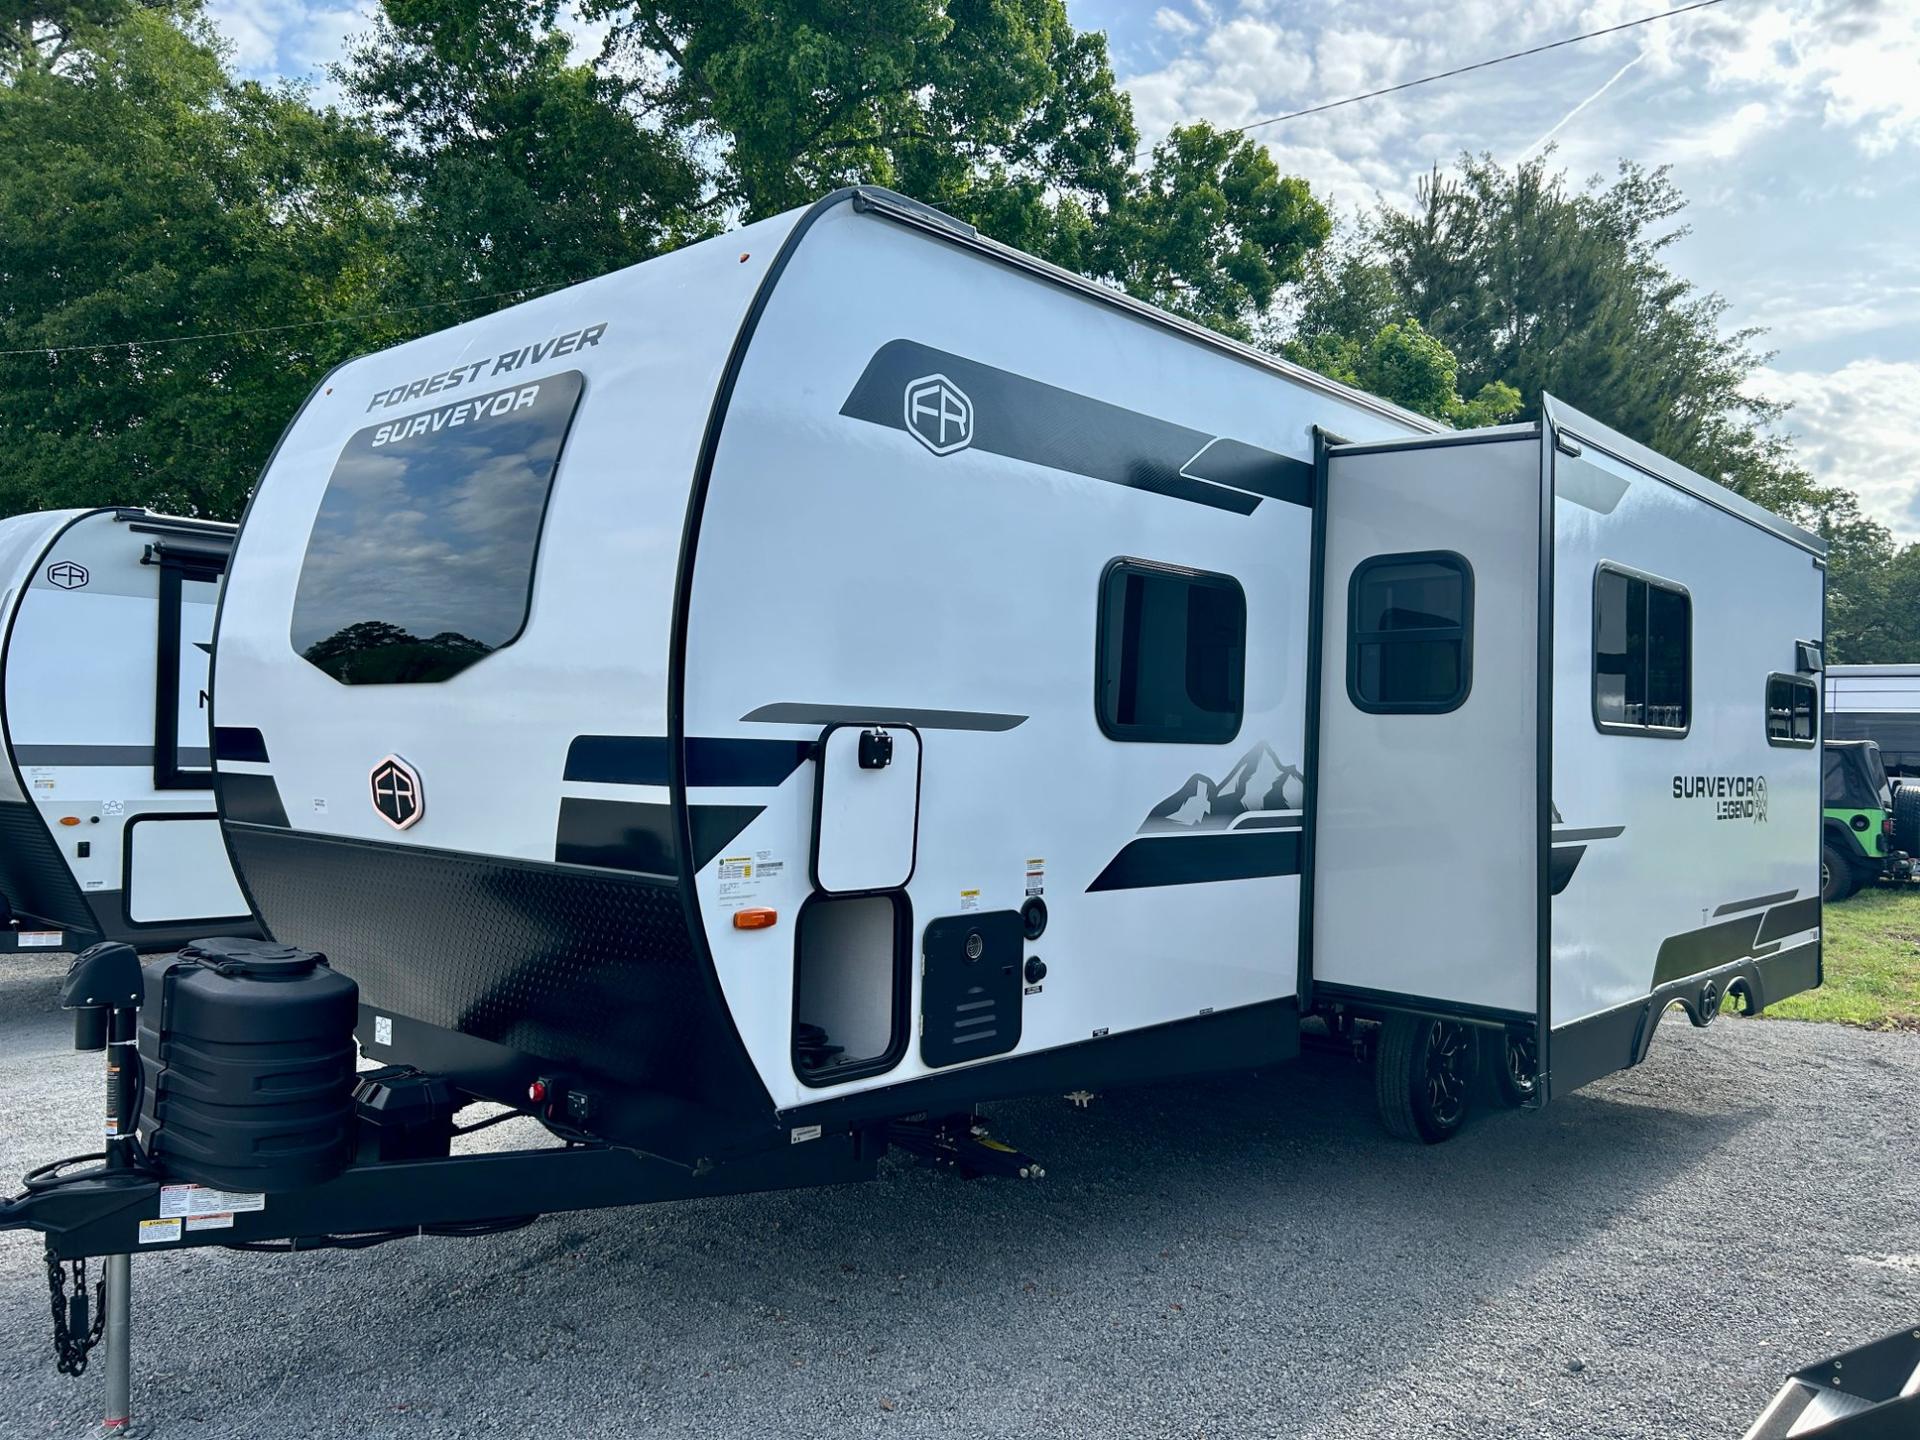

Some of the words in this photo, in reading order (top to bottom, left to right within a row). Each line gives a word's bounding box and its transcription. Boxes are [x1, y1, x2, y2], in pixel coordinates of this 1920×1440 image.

[365, 359, 491, 413] FOREST
[490, 322, 608, 376] RIVER
[372, 385, 540, 448] SURVEYOR
[1672, 776, 1754, 798] SURVEYOR
[1717, 800, 1754, 820] LEGEND
